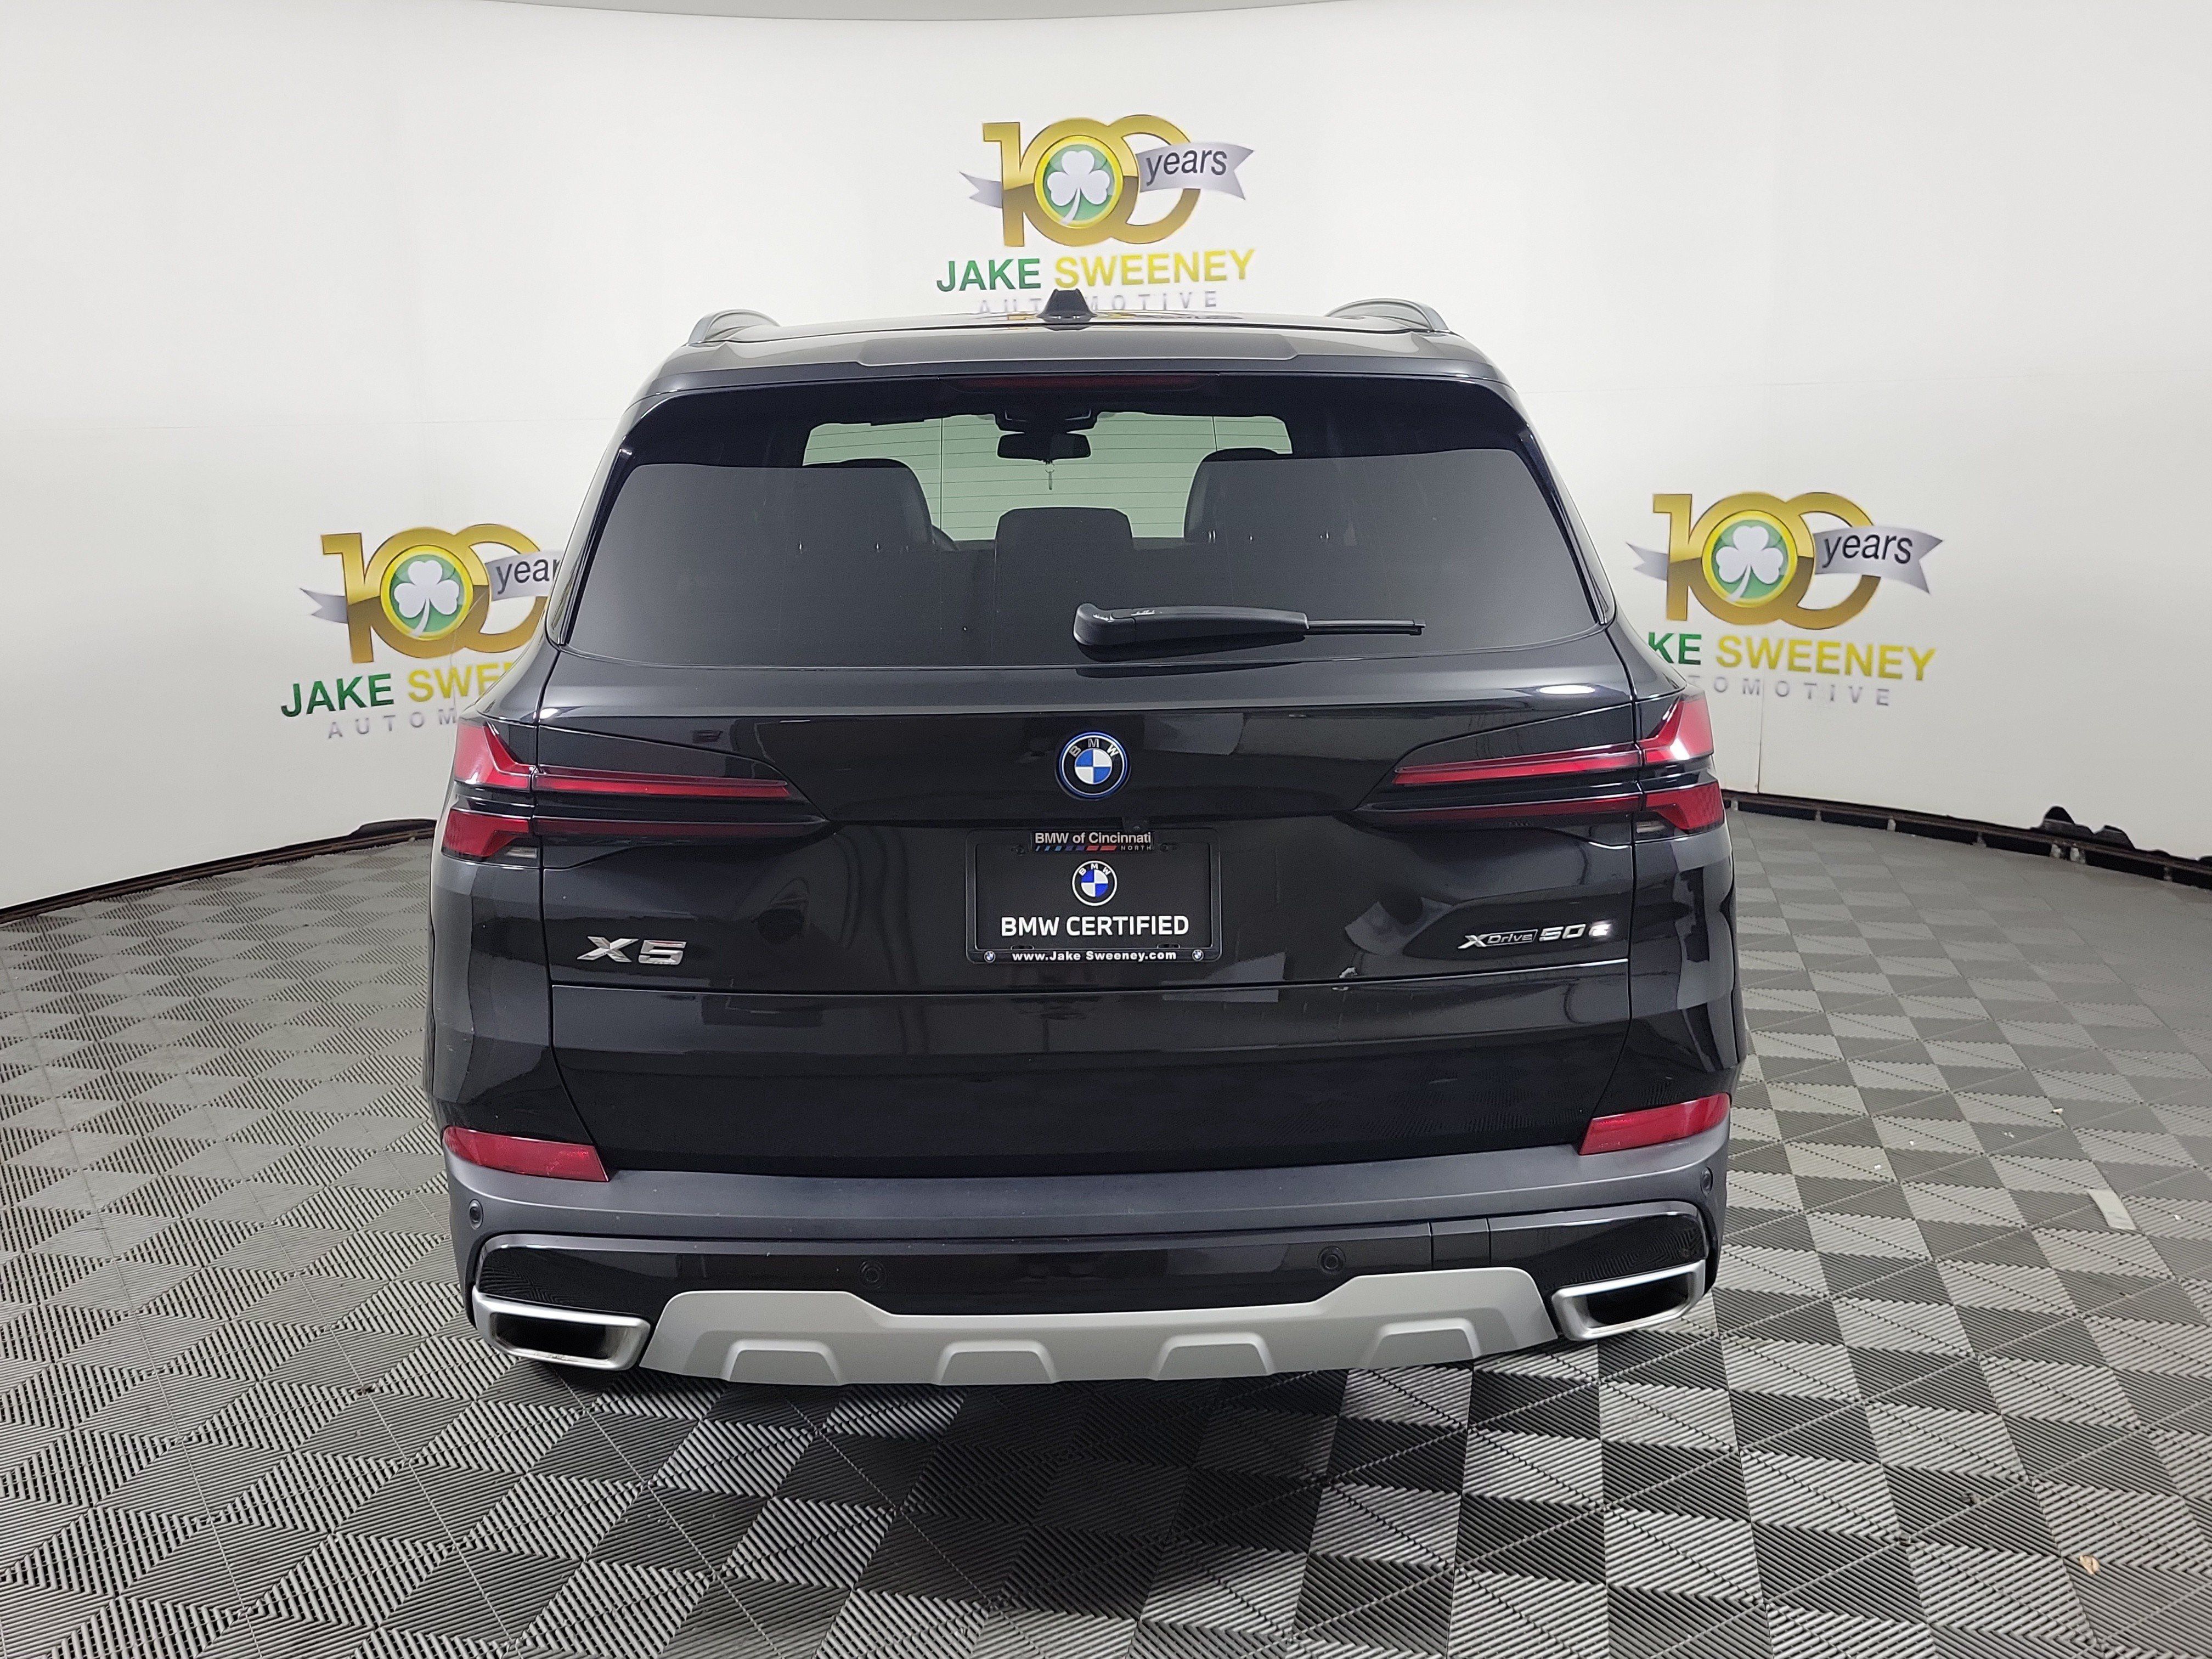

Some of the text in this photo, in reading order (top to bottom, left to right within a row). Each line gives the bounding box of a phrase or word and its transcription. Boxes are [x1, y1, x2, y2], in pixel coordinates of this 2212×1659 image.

[1146, 149, 1227, 187] years
[936, 249, 1256, 292] JAKE SWEENEY
[979, 291, 1217, 313] AUTMOTIVE
[1821, 534, 1914, 569] years
[1716, 634, 1937, 681] SWEENEY
[280, 673, 394, 718] JAKE
[1069, 737, 1119, 758] BMW
[1035, 831, 1152, 844] BMW of Cincinnati
[1079, 863, 1111, 876] BMW
[1001, 916, 1189, 936] BMW CERTIFIED
[577, 935, 687, 965] X5
[1012, 951, 1177, 962] www.Jake Sweeney.com
